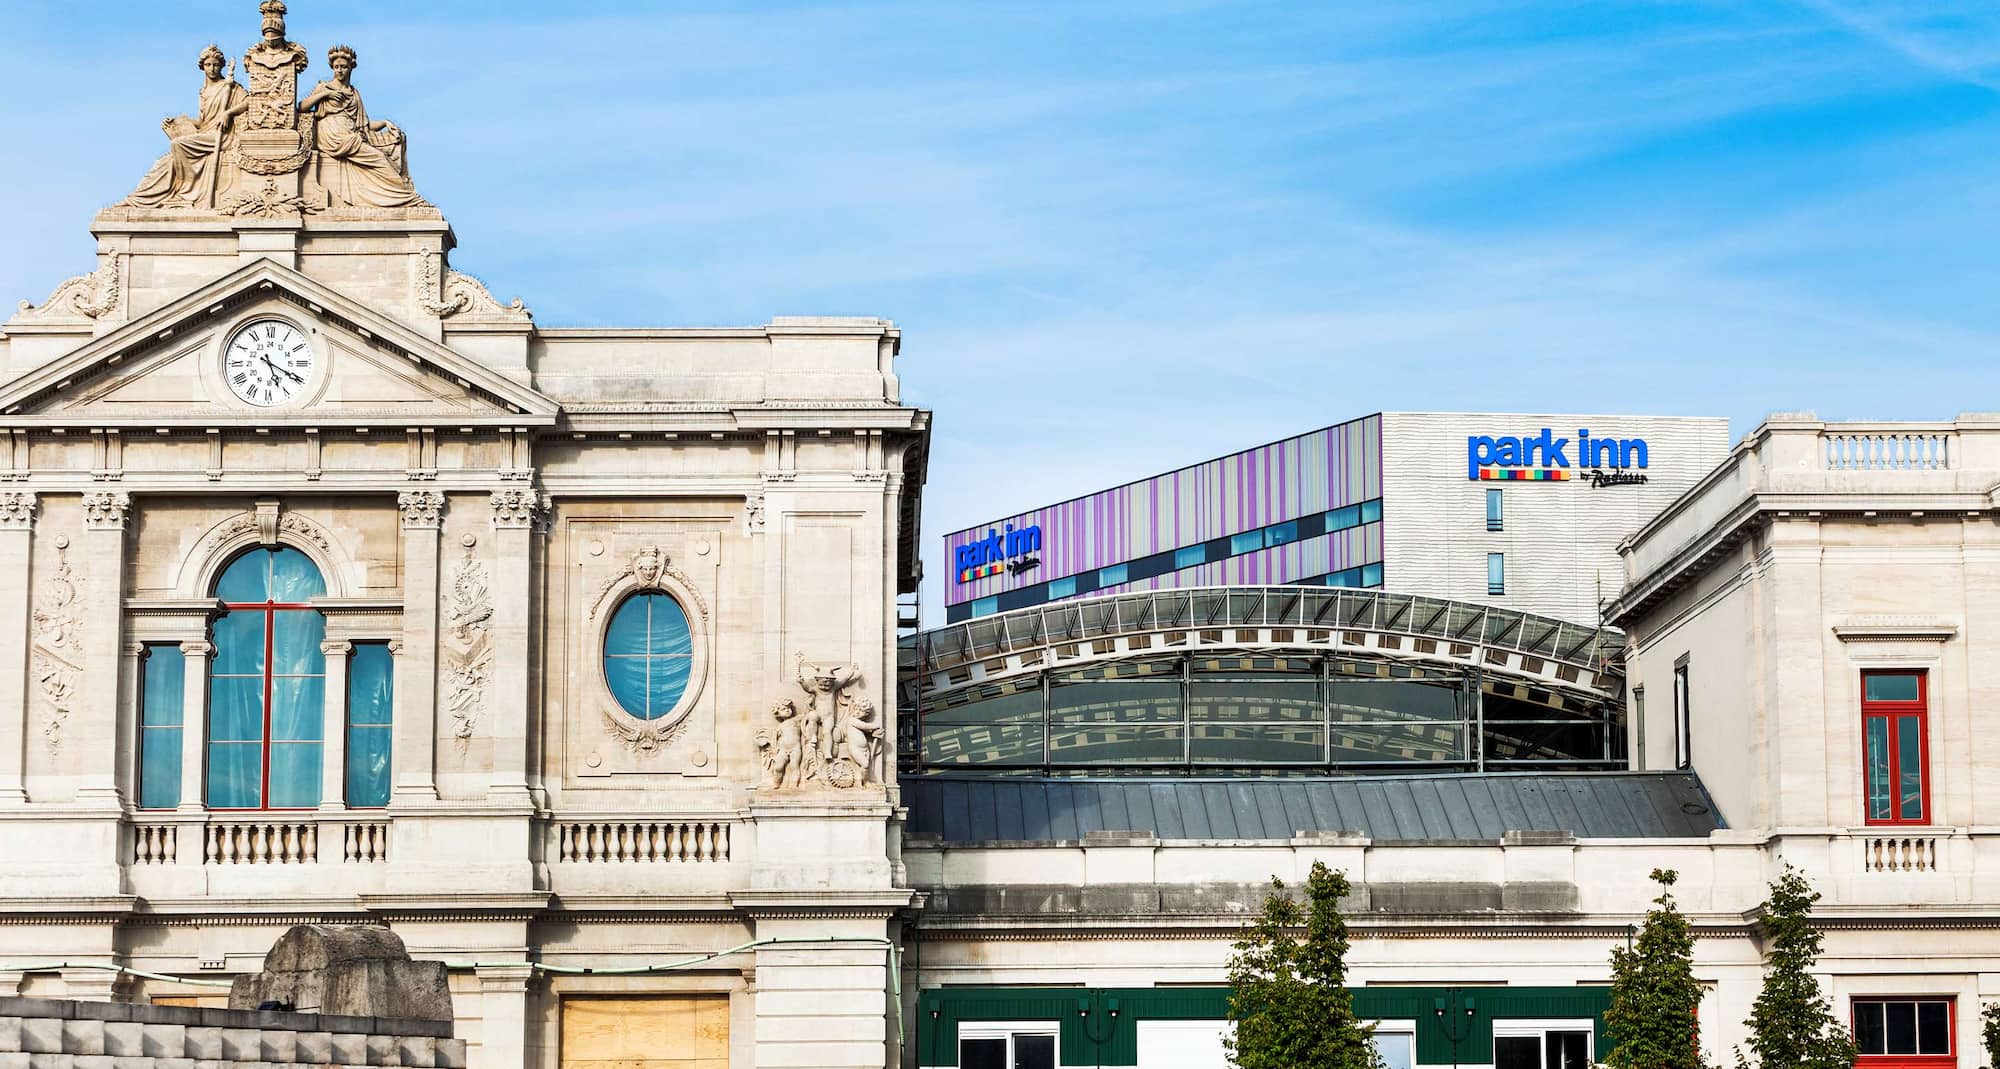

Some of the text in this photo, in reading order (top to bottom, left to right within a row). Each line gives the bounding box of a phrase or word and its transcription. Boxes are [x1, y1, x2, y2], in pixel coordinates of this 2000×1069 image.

[1468, 428, 1648, 481] park inn
[955, 528, 1004, 584] park
[1006, 524, 1041, 557] inn
